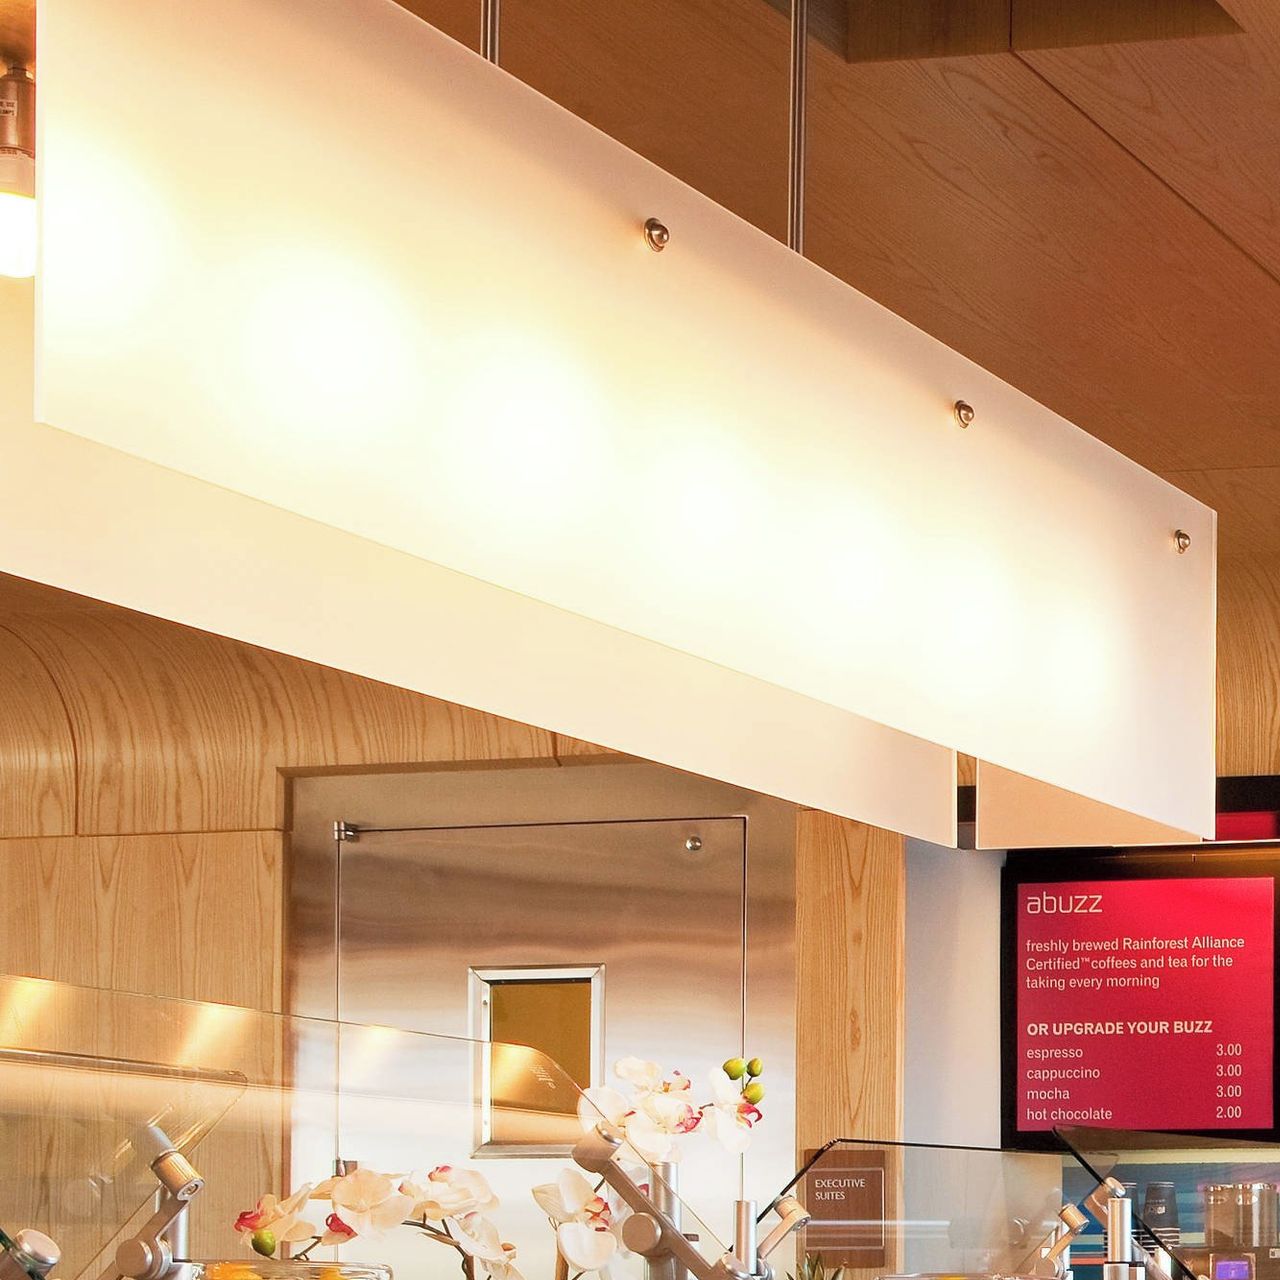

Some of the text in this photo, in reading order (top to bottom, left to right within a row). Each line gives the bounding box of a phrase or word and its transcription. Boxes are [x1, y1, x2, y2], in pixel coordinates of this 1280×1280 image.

[1027, 891, 1102, 913] abuzz
[1026, 936, 1244, 954] freshly brewed Rainforest Alliance
[1091, 956, 1136, 969] coffees
[1141, 956, 1164, 968] and
[1168, 956, 1188, 967] tea
[1191, 955, 1209, 967] for
[1213, 955, 1233, 967] the
[1027, 1021, 1212, 1035] OR UPGRADE YOUR BUZZ
[1027, 1048, 1083, 1061] espresso
[1217, 1043, 1241, 1056] 3.00
[1027, 1068, 1100, 1081] cappuccino
[1217, 1064, 1241, 1076] 3.00
[1027, 1087, 1069, 1099] mocha
[1217, 1085, 1241, 1097] 3.00
[1027, 1108, 1112, 1120] hot chocolate
[1217, 1106, 1241, 1118] 2.00
[815, 1179, 866, 1188] EXECUTIVE
[815, 1191, 846, 1200] SUITES
